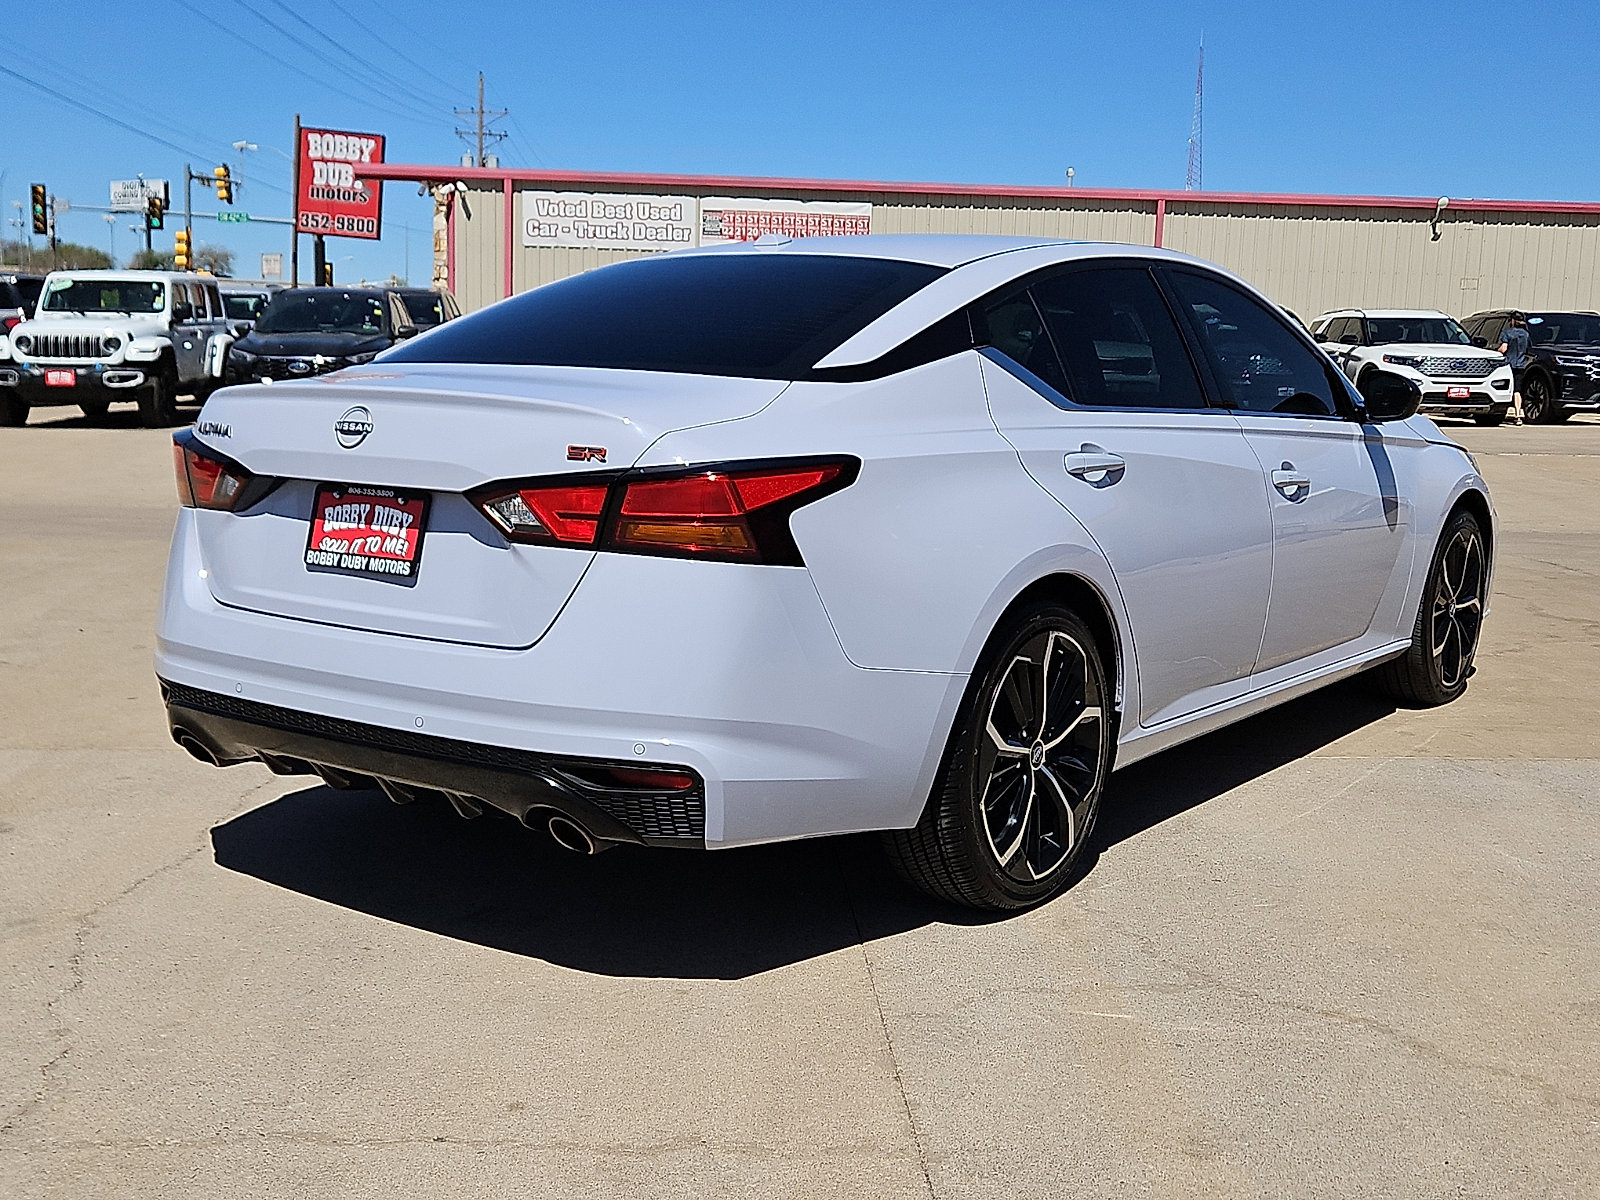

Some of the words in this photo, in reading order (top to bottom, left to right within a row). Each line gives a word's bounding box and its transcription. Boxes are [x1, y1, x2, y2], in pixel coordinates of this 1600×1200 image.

[308, 132, 376, 162] BOBBY
[312, 160, 355, 188] DUB
[310, 185, 369, 204] motors
[536, 198, 587, 218] Voted
[591, 200, 632, 220] Best
[637, 202, 682, 221] Used
[300, 211, 376, 233] 352-9800
[526, 219, 558, 237] Car
[562, 226, 570, 234] -
[573, 220, 630, 240] Truck
[633, 222, 691, 242] Dealer
[723, 227, 734, 235] 22
[748, 228, 758, 236] 20
[335, 422, 372, 432] NISSAN
[566, 445, 607, 463] SR
[323, 504, 370, 532] BOBBY
[371, 505, 413, 539] DUBY
[319, 536, 349, 554] SOLD
[349, 538, 365, 554] IT
[364, 536, 382, 553] TO
[382, 536, 410, 557] ME!
[306, 550, 340, 566] BOBBY
[341, 554, 368, 570] DUBY
[368, 558, 411, 576] MOTORS
